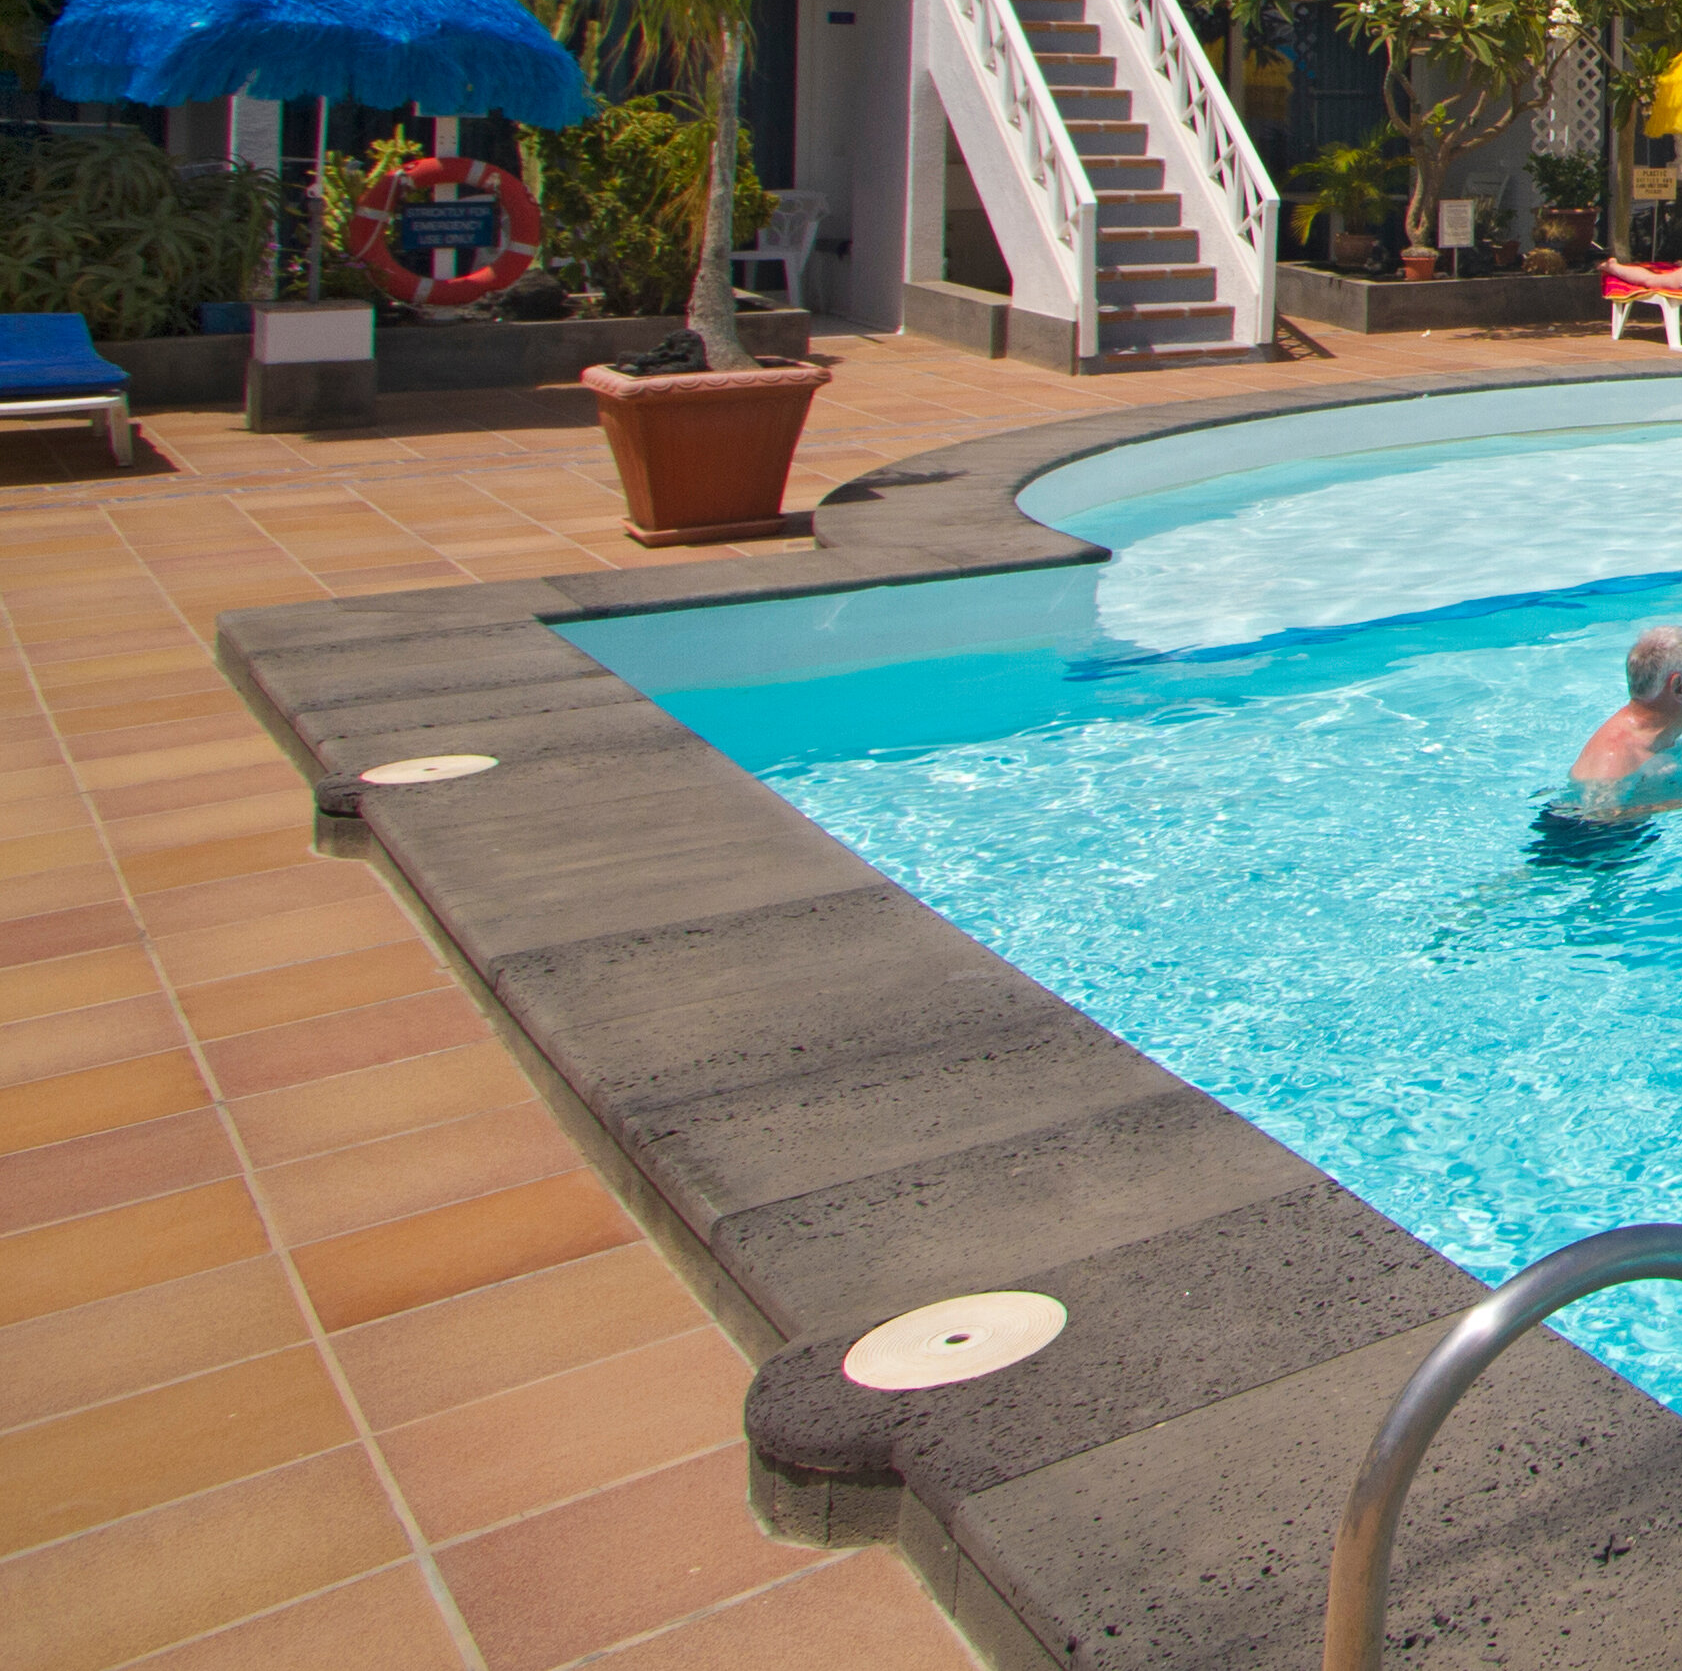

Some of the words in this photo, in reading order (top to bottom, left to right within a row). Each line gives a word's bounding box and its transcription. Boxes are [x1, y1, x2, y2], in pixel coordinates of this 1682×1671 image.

[1642, 169, 1668, 178] PLASTIC
[407, 207, 465, 217] STRICTLY
[469, 206, 491, 217] FOR
[413, 221, 482, 231] EMERGENCY
[419, 234, 443, 244] USE
[446, 233, 476, 244] ONLY
